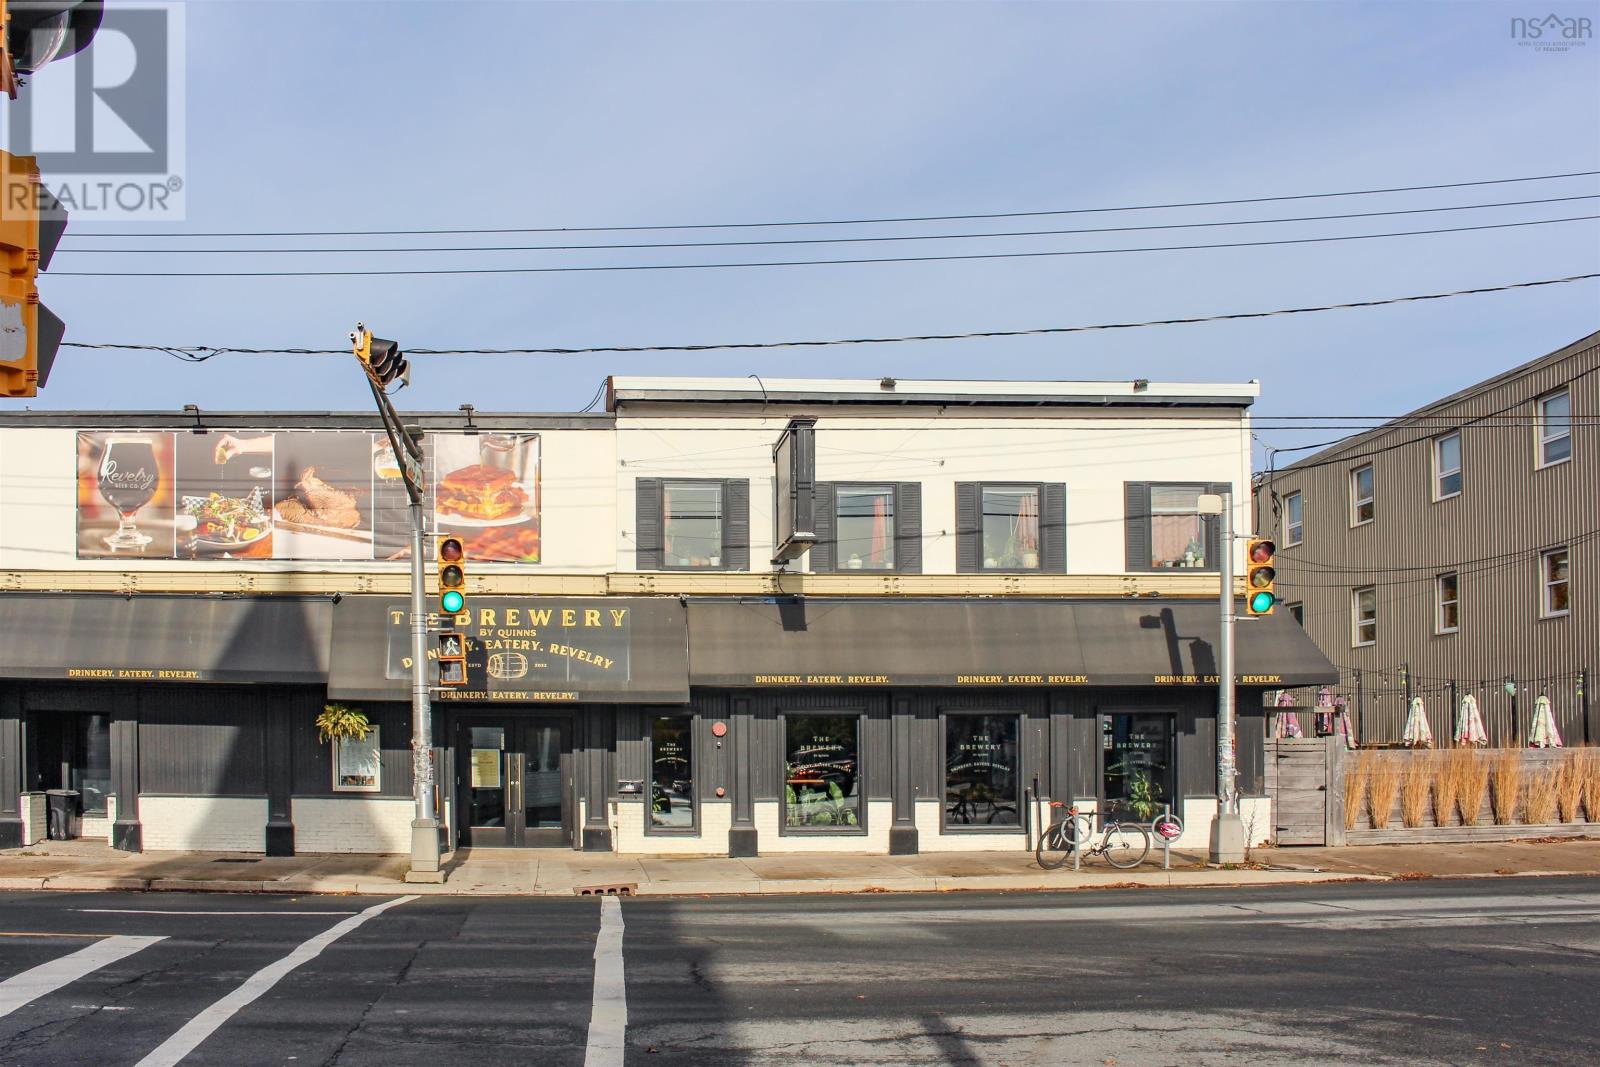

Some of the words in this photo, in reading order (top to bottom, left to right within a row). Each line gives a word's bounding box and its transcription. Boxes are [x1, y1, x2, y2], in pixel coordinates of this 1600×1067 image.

[101, 460, 154, 490] Revelry
[455, 608, 627, 627] BREWERY
[480, 628, 494, 637] BY
[497, 629, 537, 639] QUINNS
[484, 639, 544, 652] EATERY.
[549, 643, 614, 669] REVELRY
[69, 669, 115, 677] DRINKERY.
[120, 670, 155, 678] EATERY.
[159, 670, 199, 679] REVELRY.
[957, 675, 1004, 683] DRINKERY.
[1008, 675, 1044, 683] EATERY.
[1048, 675, 1089, 683] REVELRY.
[1154, 675, 1200, 683] DRINKERY.
[1242, 675, 1282, 683] REVELRY.
[755, 675, 803, 683] DRINKERY.
[807, 675, 844, 683] EATERY.
[848, 675, 889, 684] REVELRY.
[440, 691, 488, 699] DRINKERY.
[492, 691, 529, 699] EATERY.
[533, 692, 576, 700] REVELRY.
